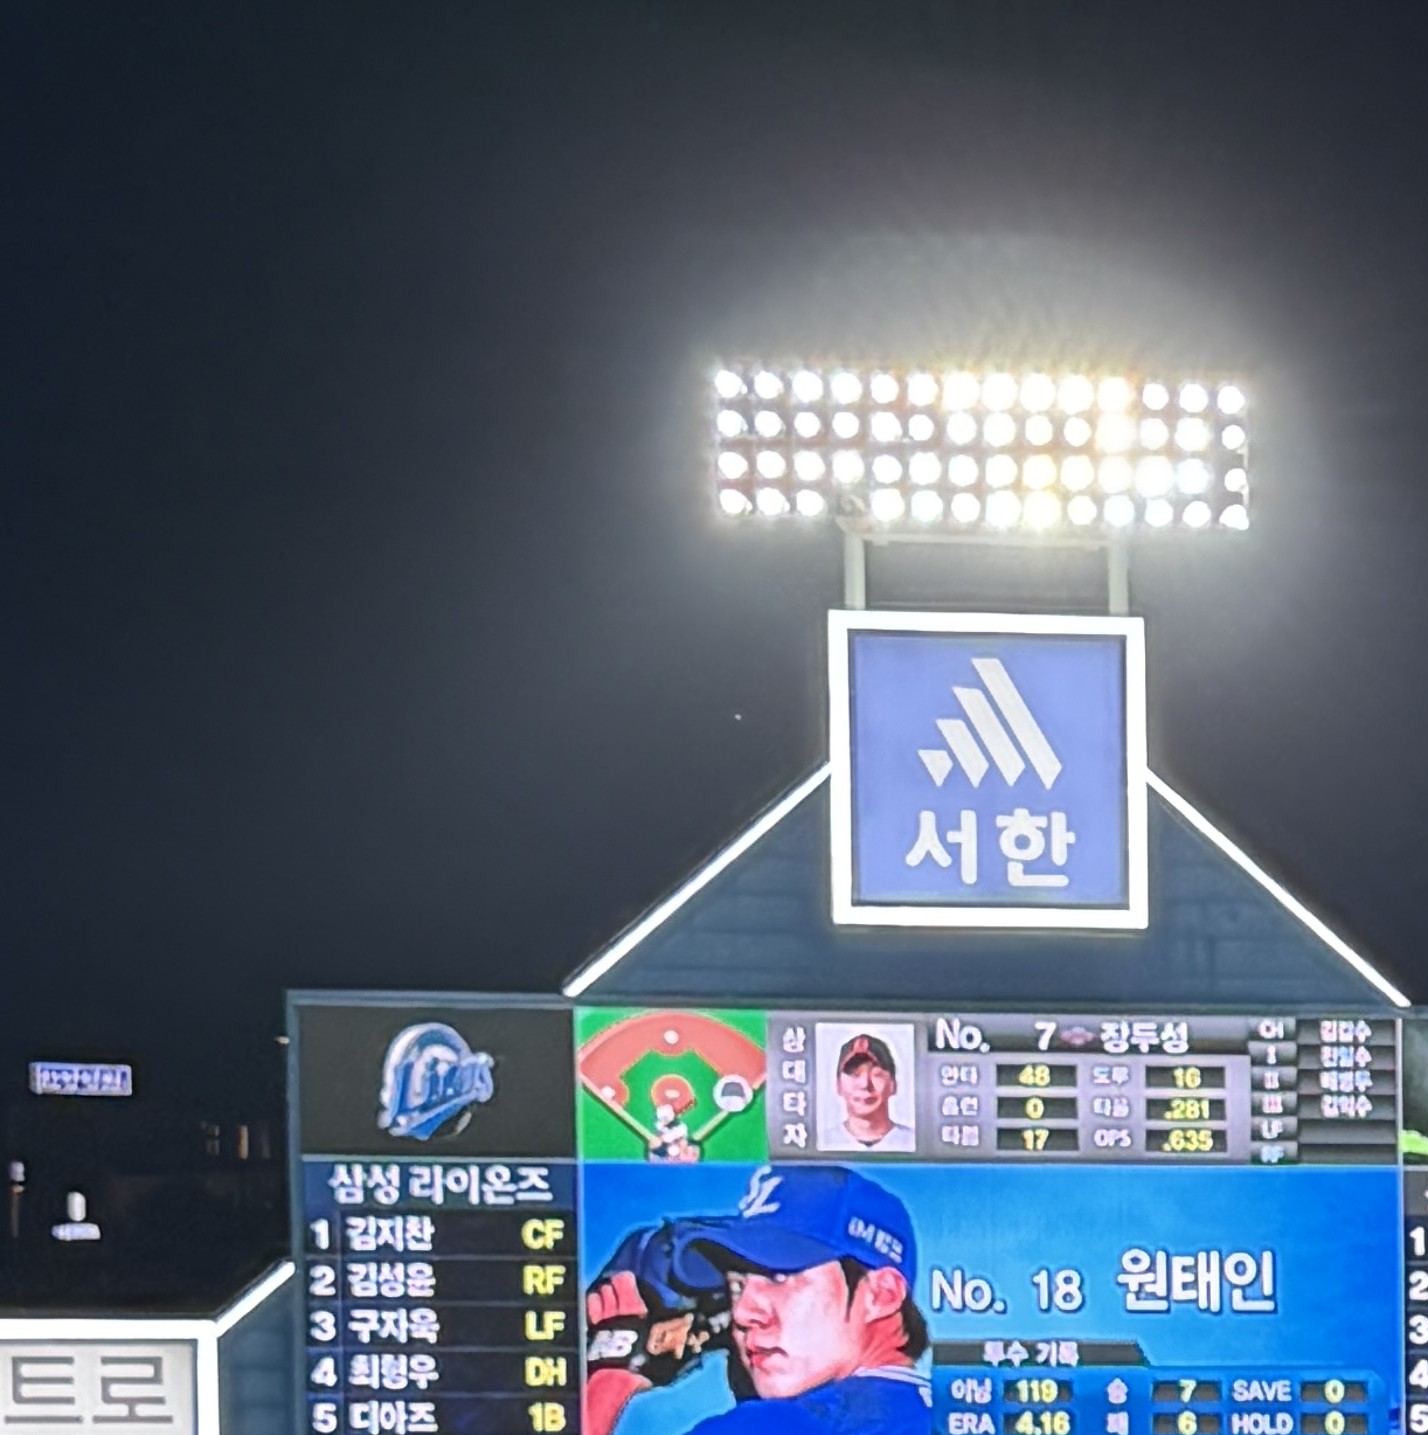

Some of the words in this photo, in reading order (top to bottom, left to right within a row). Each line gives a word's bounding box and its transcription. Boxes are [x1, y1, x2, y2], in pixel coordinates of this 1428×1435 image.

[905, 808, 1076, 887] 서한
[936, 1018, 990, 1053] No.
[1034, 1021, 1056, 1050] 7
[1100, 1021, 1190, 1053] 장두성
[1019, 1064, 1050, 1086] 48
[1164, 1098, 1210, 1120] .281
[1022, 1129, 1050, 1151] 17
[329, 1165, 402, 1204] 삼성
[409, 1165, 553, 1204] 라이온즈
[347, 1215, 435, 1252] 김지찬
[522, 1219, 564, 1249] CF
[348, 1262, 436, 1299] 김성윤
[524, 1266, 565, 1295] RF
[931, 1269, 1007, 1313] No.
[1032, 1269, 1083, 1312] 18
[1117, 1248, 1277, 1314] 원태인
[349, 1308, 441, 1343] 구자욱
[525, 1311, 565, 1339] LF
[524, 1356, 567, 1387] DH
[4, 1355, 174, 1424] 트로
[1016, 1379, 1058, 1403] 119
[1179, 1380, 1196, 1403] 7
[1232, 1379, 1292, 1403] SAVE
[1324, 1379, 1345, 1403] 0
[349, 1400, 438, 1435] 디아즈
[528, 1402, 567, 1432] 1B
[948, 1413, 995, 1435] ERA
[1324, 1412, 1345, 1435] 0
